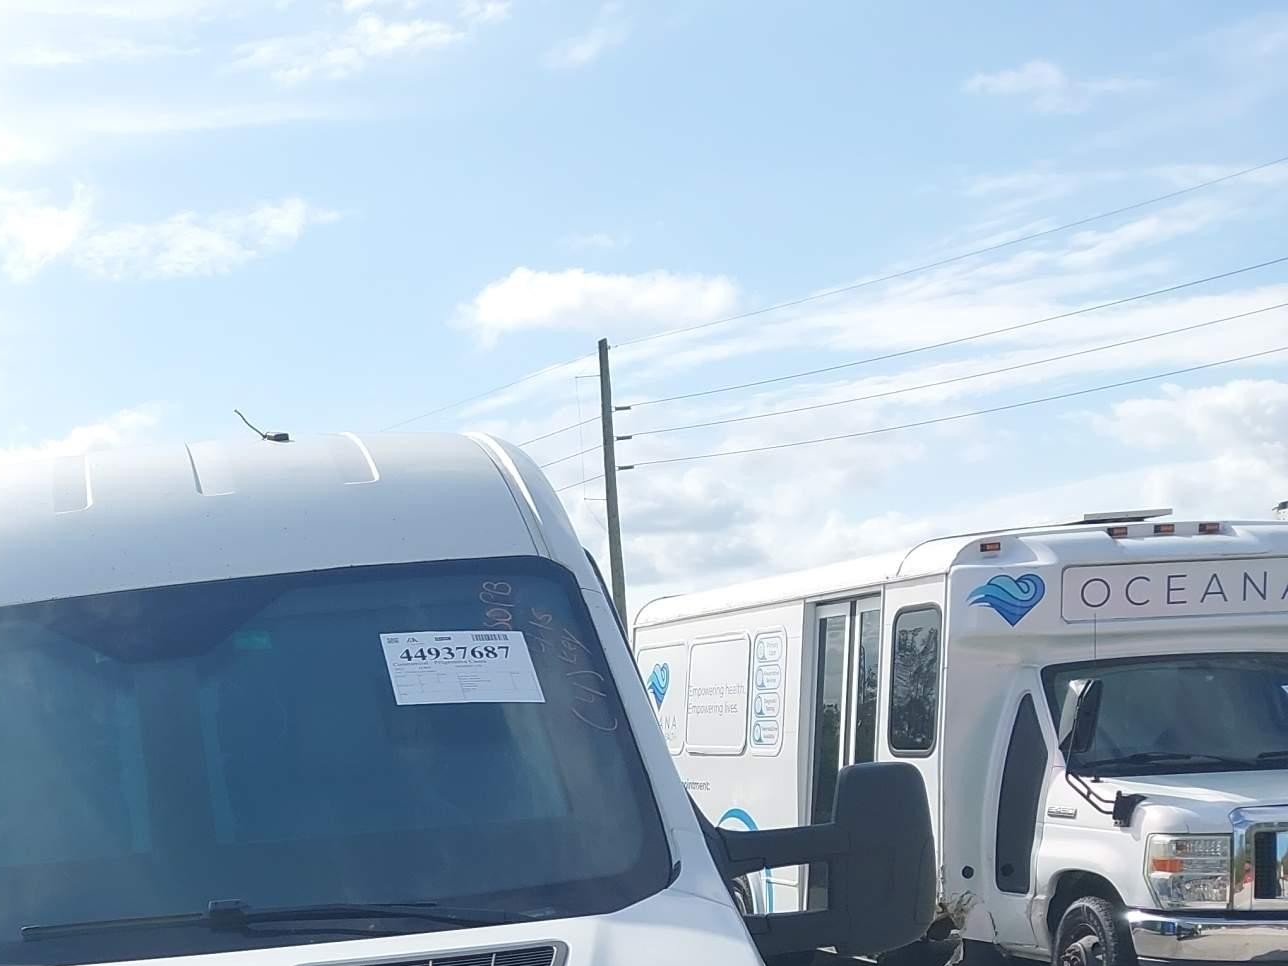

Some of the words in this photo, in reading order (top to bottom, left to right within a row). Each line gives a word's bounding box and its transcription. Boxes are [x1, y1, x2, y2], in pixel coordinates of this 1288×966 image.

[399, 646, 510, 661] 44937687
[688, 685, 724, 698] Empowering
[687, 702, 723, 716] Empowering
